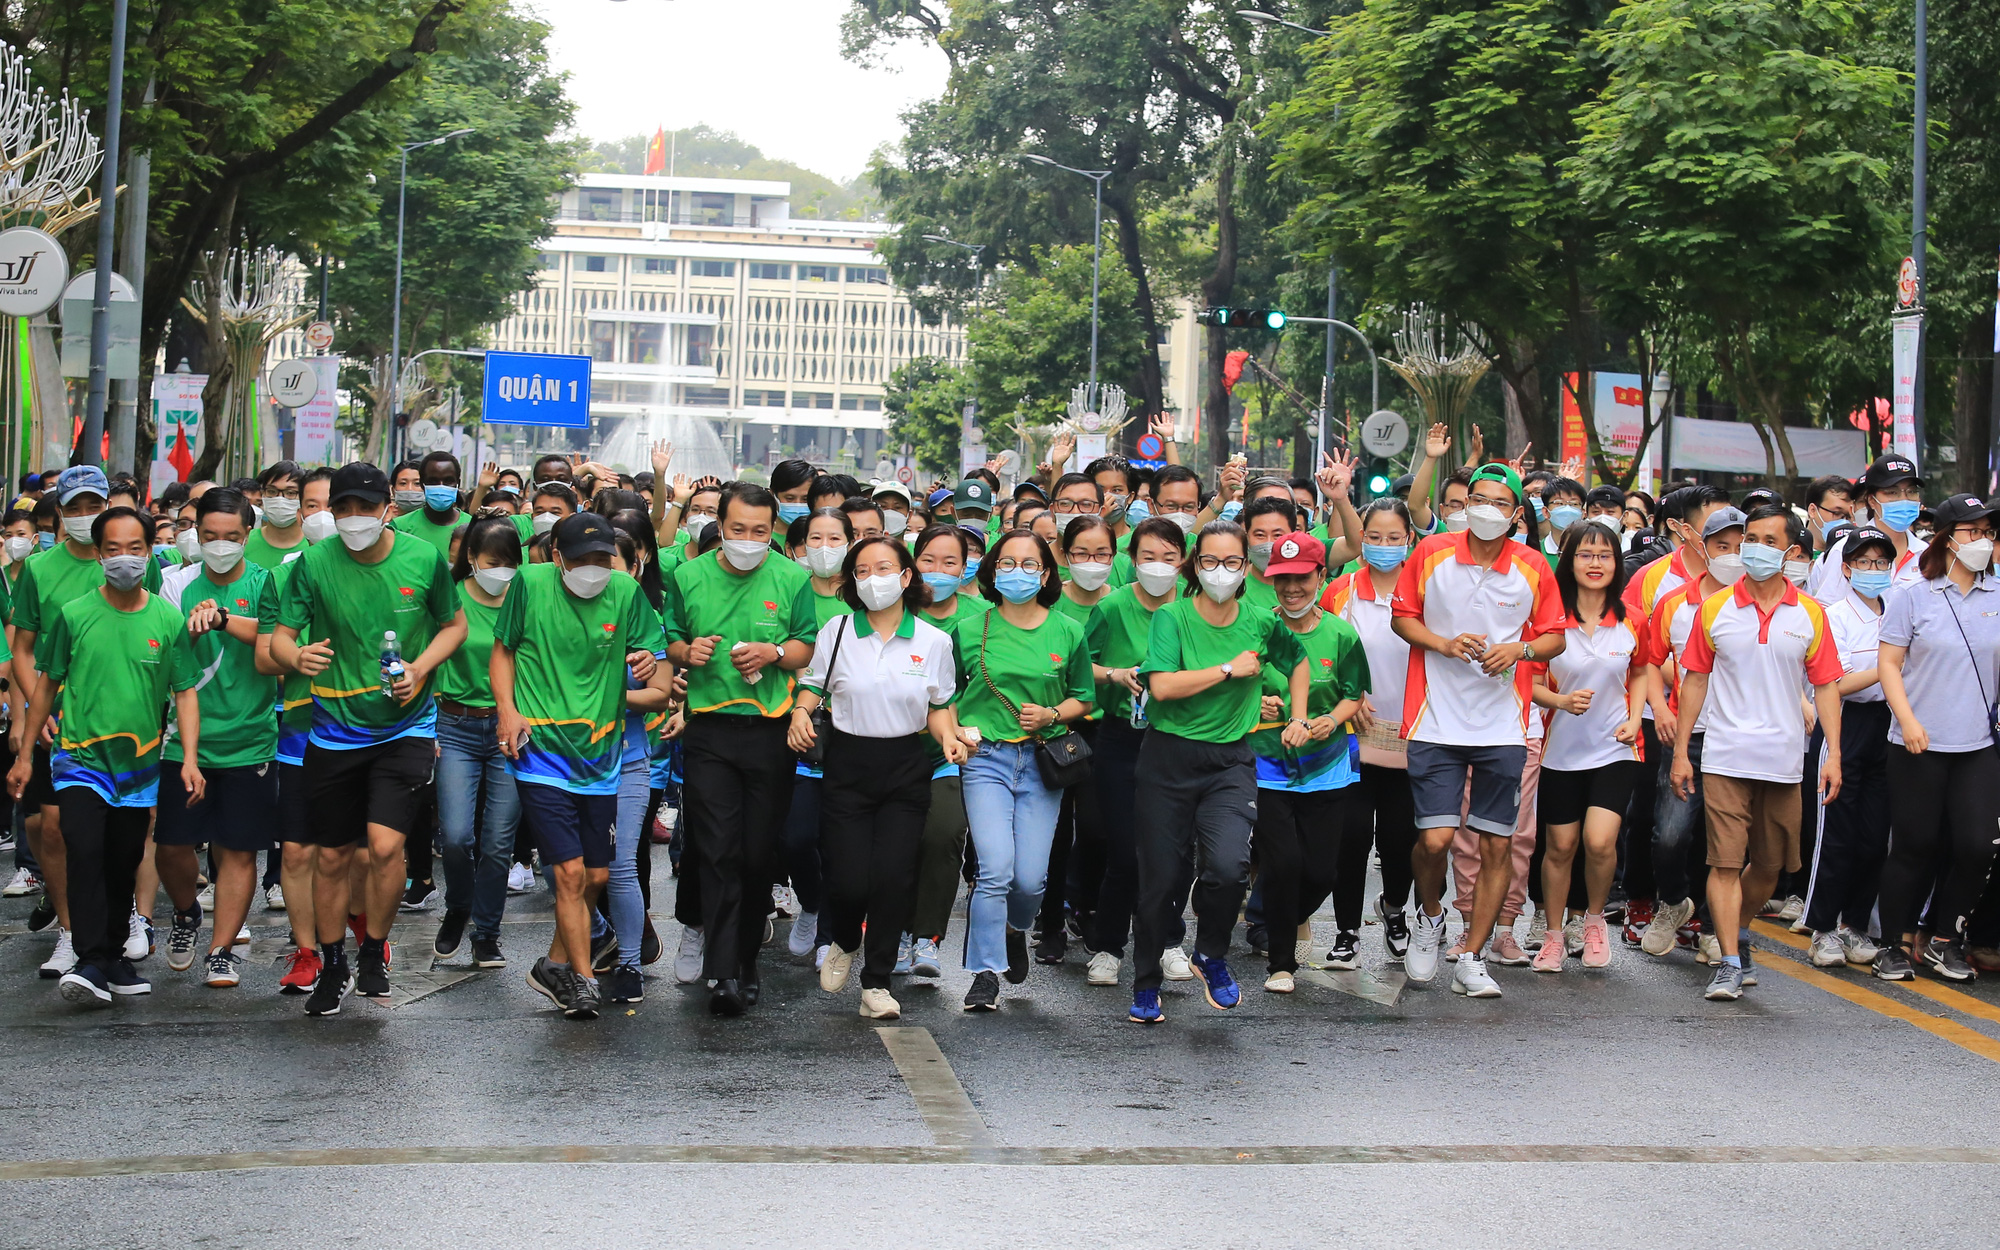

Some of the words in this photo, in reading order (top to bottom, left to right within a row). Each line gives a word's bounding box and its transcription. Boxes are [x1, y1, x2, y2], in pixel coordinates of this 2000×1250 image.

[0, 287, 15, 295] Viva
[18, 287, 38, 295] Land
[1219, 309, 1228, 324] 1
[499, 373, 561, 406] QUẬN
[568, 380, 578, 402] 1
[1784, 630, 1801, 639] HDBank
